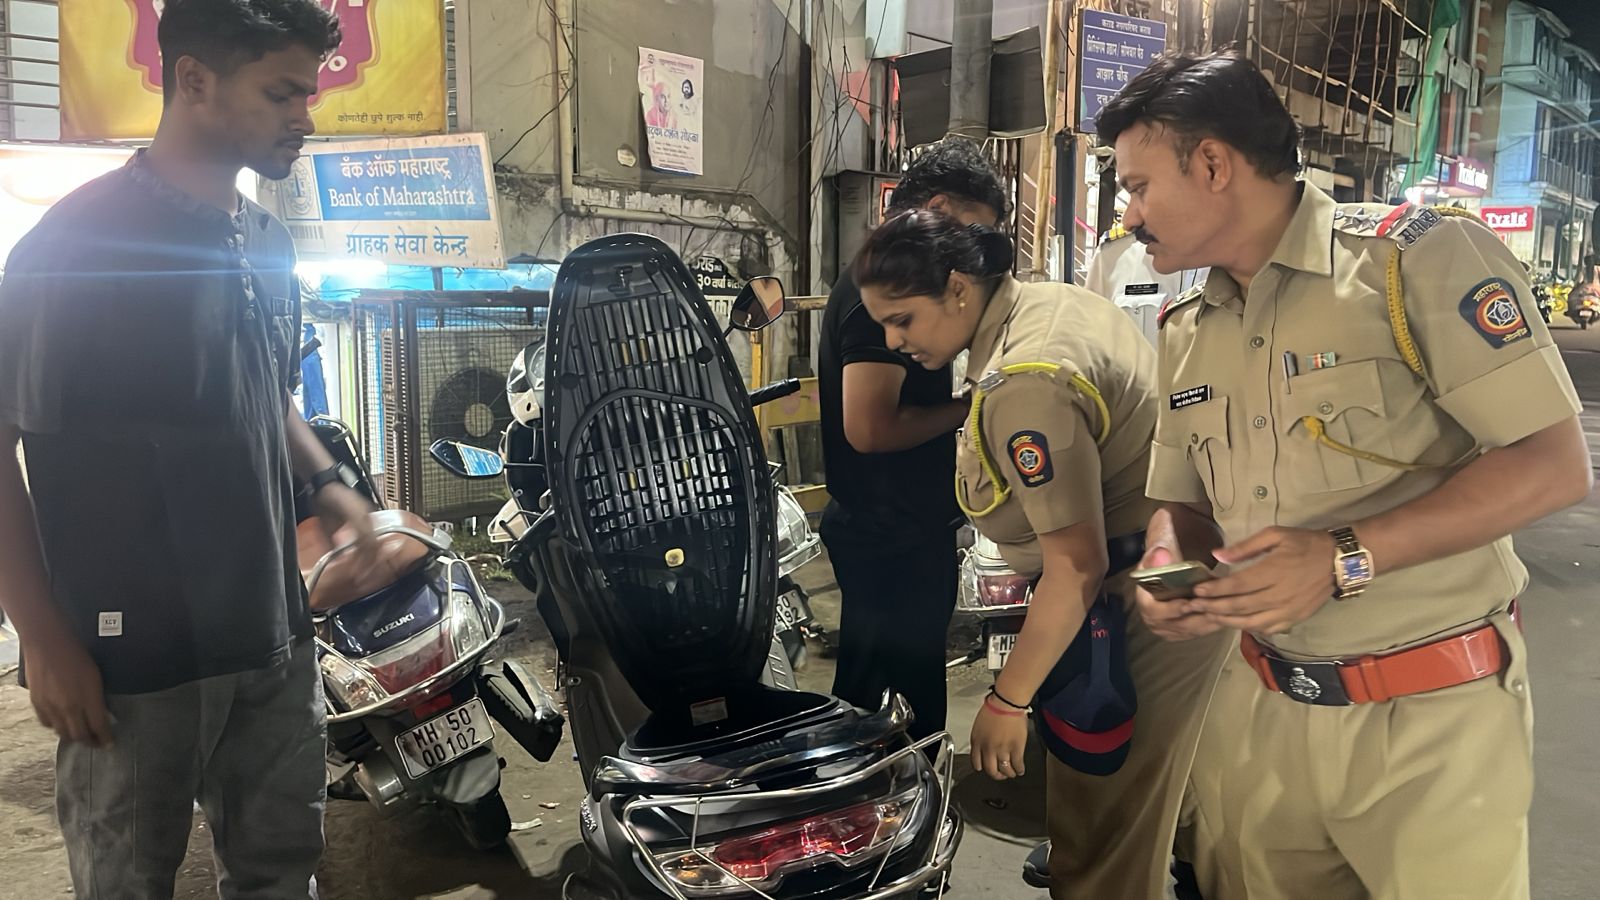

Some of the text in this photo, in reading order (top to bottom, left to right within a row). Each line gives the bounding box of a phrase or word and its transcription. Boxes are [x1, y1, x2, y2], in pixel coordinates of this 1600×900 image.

[340, 155, 452, 180] बँक ऑफ महाराष्ट्र
[328, 185, 477, 208] Bank of Maharashtra
[345, 226, 469, 258] ग्राहक सेवा केन्द्र
[697, 274, 711, 290] ३०
[373, 612, 415, 638] SUZUKI
[413, 707, 471, 749] MH 50
[422, 728, 481, 768] 00102
